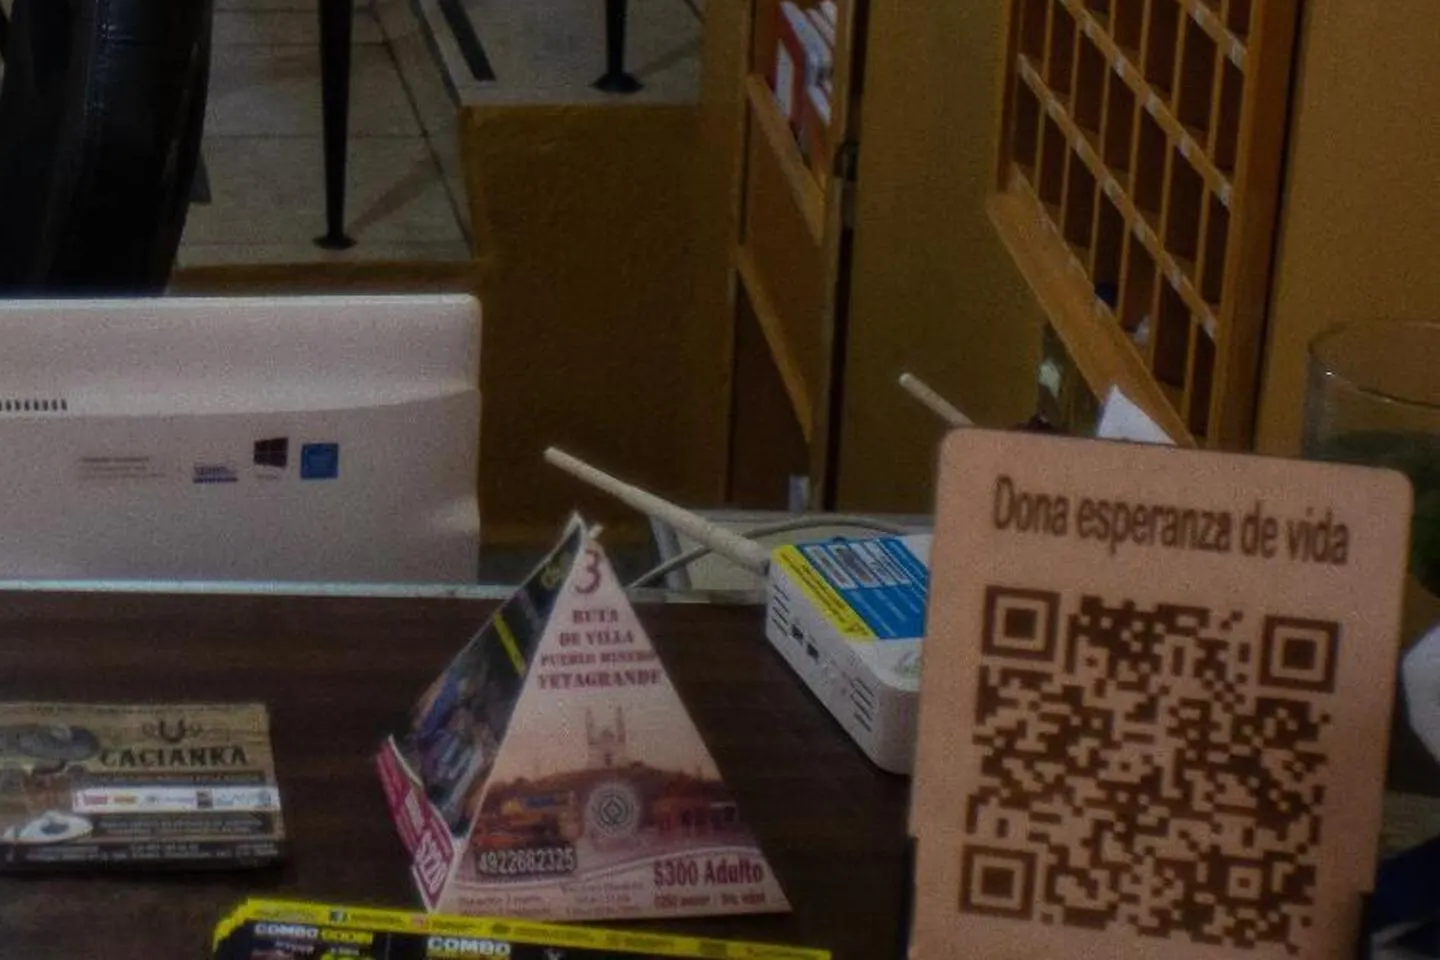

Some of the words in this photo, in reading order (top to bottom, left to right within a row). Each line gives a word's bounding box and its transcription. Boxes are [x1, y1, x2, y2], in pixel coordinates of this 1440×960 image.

[993, 474, 1068, 536] Dona
[1076, 497, 1232, 555] esperanza
[1240, 500, 1277, 558] de
[1286, 506, 1349, 565] vida
[574, 549, 602, 595] 3
[559, 632, 581, 647] DE
[585, 630, 635, 646] VILLA
[653, 859, 699, 887] $300
[704, 858, 764, 885] Adulto
[254, 922, 320, 941] COMBO
[426, 936, 511, 956] COMBO
